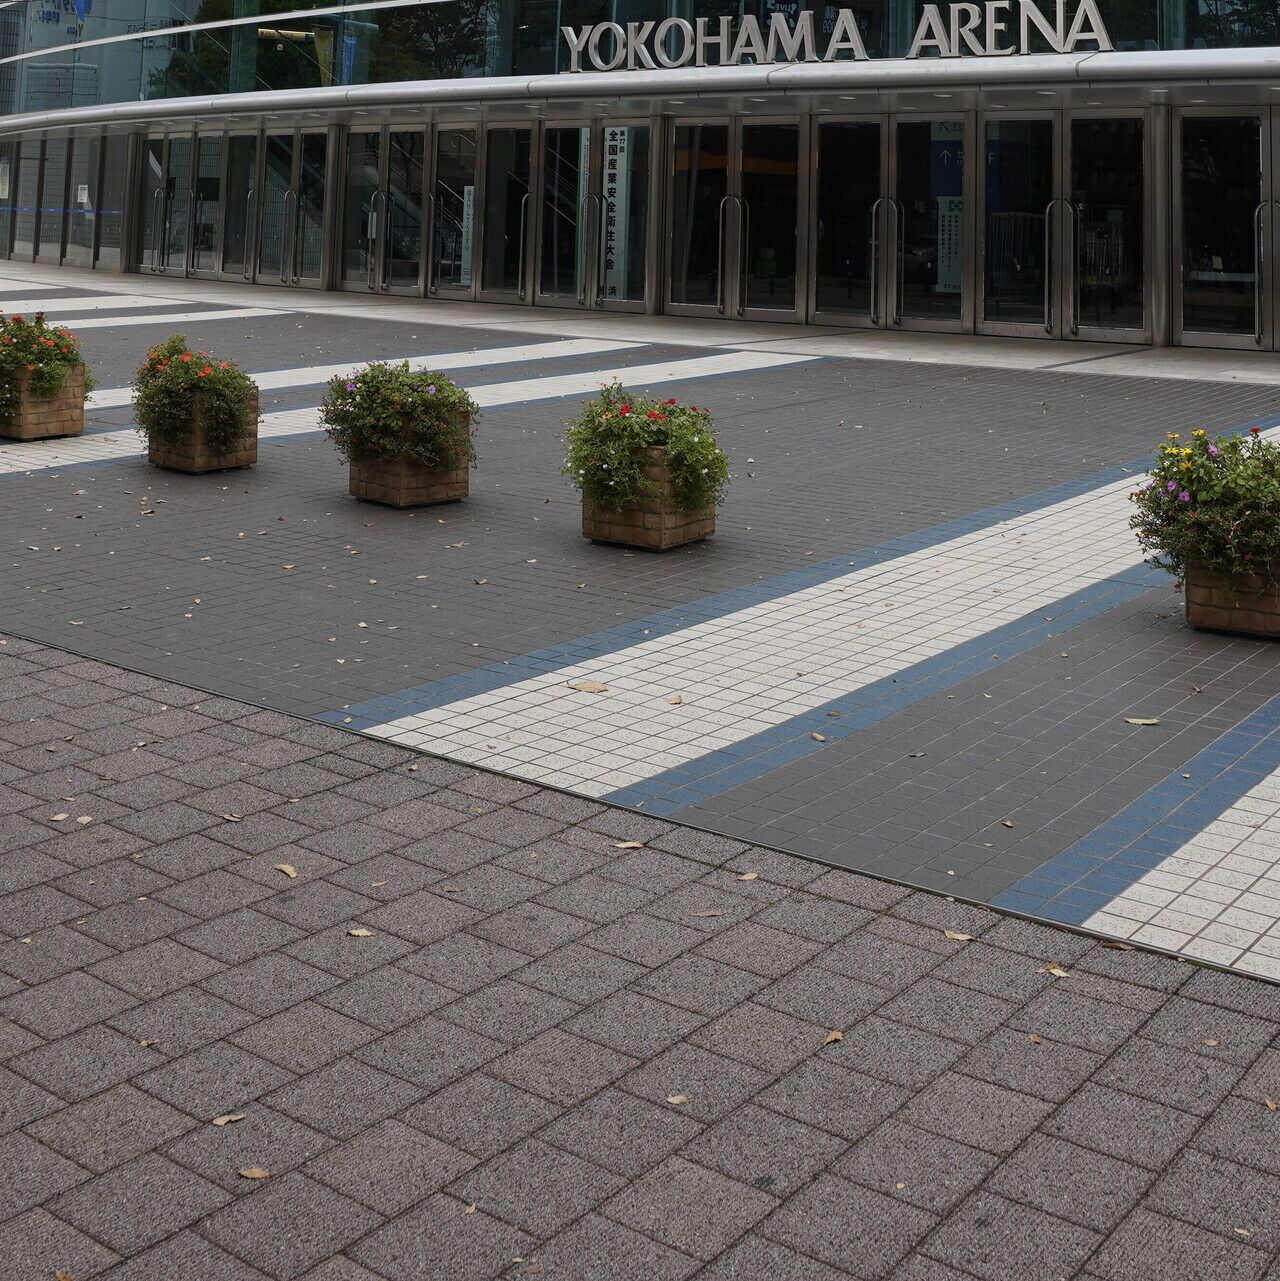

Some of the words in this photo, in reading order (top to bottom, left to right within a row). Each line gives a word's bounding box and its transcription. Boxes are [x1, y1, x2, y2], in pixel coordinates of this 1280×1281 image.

[560, 8, 871, 73] YOKOHAMA
[606, 129, 619, 271] 全国産業安全衛生大会
